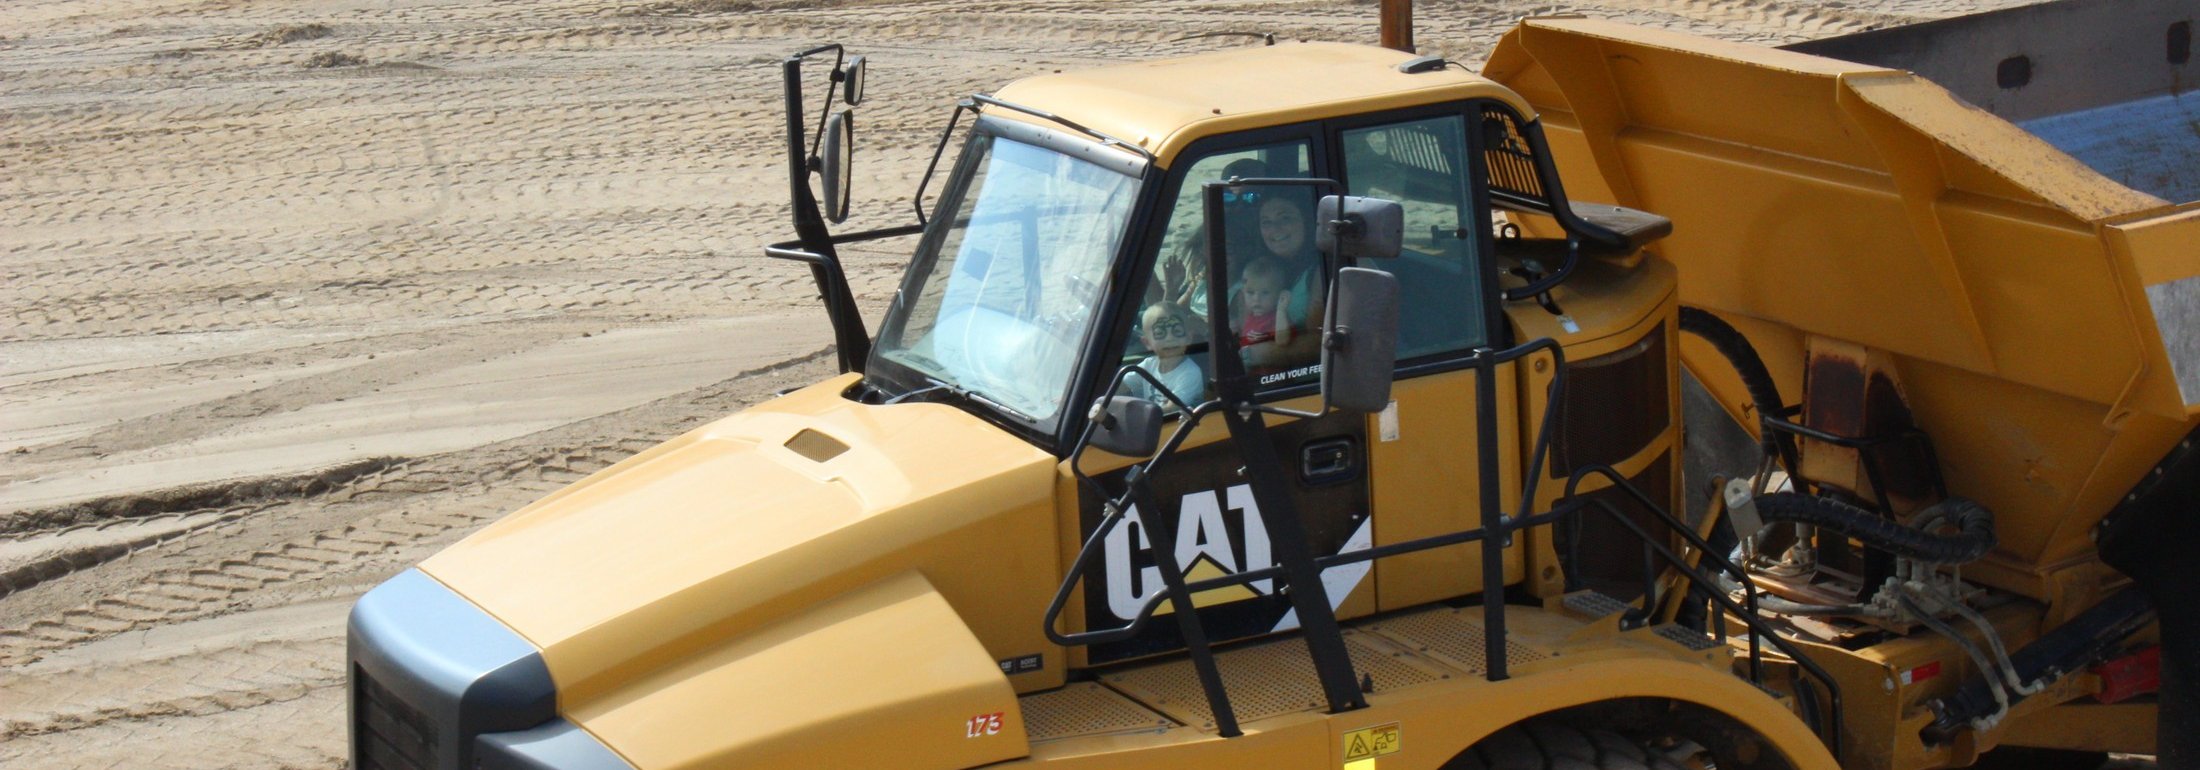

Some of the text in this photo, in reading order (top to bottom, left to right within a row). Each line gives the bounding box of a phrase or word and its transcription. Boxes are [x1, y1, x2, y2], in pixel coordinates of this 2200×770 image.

[1260, 364, 1324, 384] CLEAN YOUR FEE
[1104, 484, 1275, 620] CAT
[966, 711, 1005, 738] 173
